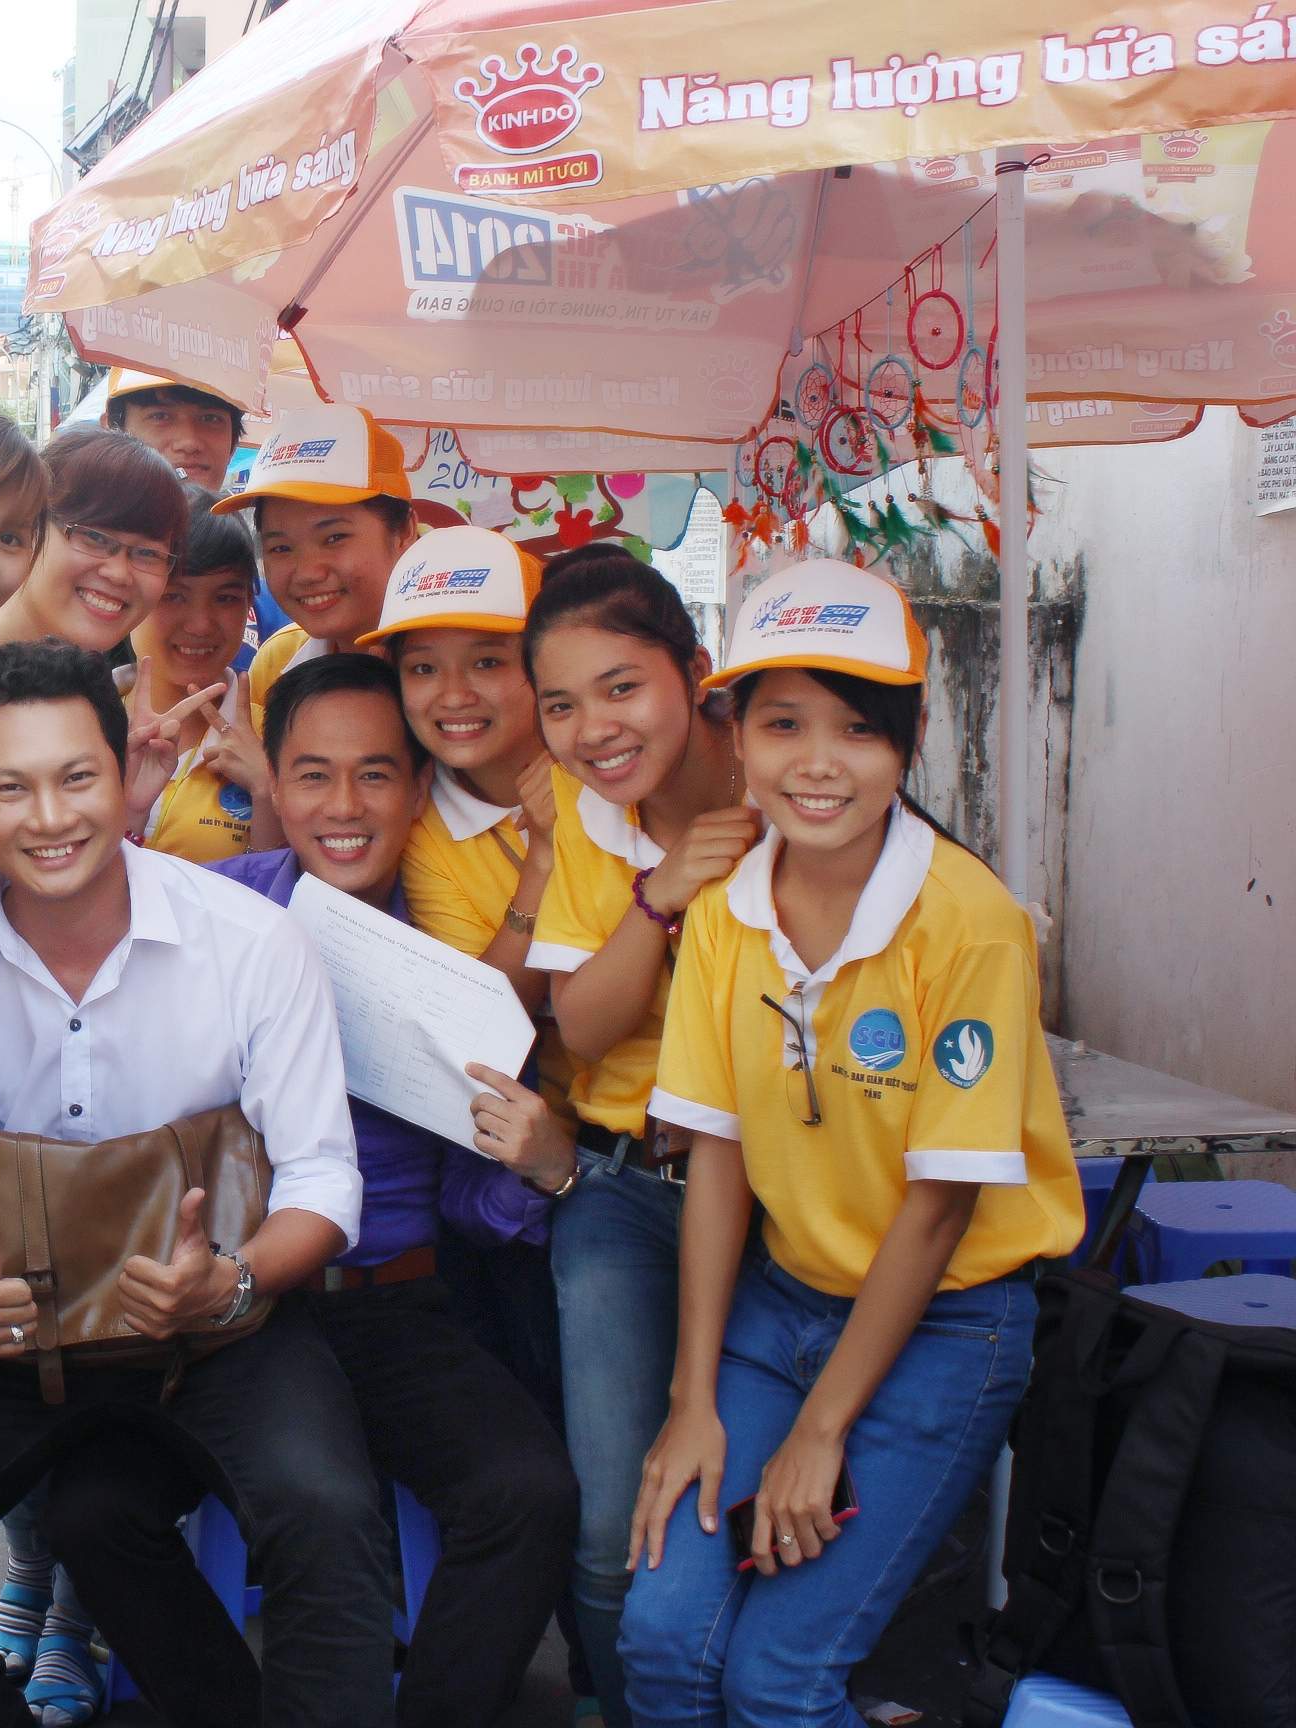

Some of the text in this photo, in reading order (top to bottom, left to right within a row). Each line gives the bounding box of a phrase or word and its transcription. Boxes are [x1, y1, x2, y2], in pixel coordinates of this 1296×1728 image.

[640, 74, 812, 131] Năng
[831, 52, 1023, 117] lượng
[1040, 27, 1175, 85] bữa
[236, 155, 288, 211] bữa
[292, 130, 356, 191] sáng
[469, 161, 588, 186] BÁNH MÌ TƯƠI
[798, 614, 816, 625] THI
[855, 1025, 902, 1051] SGU
